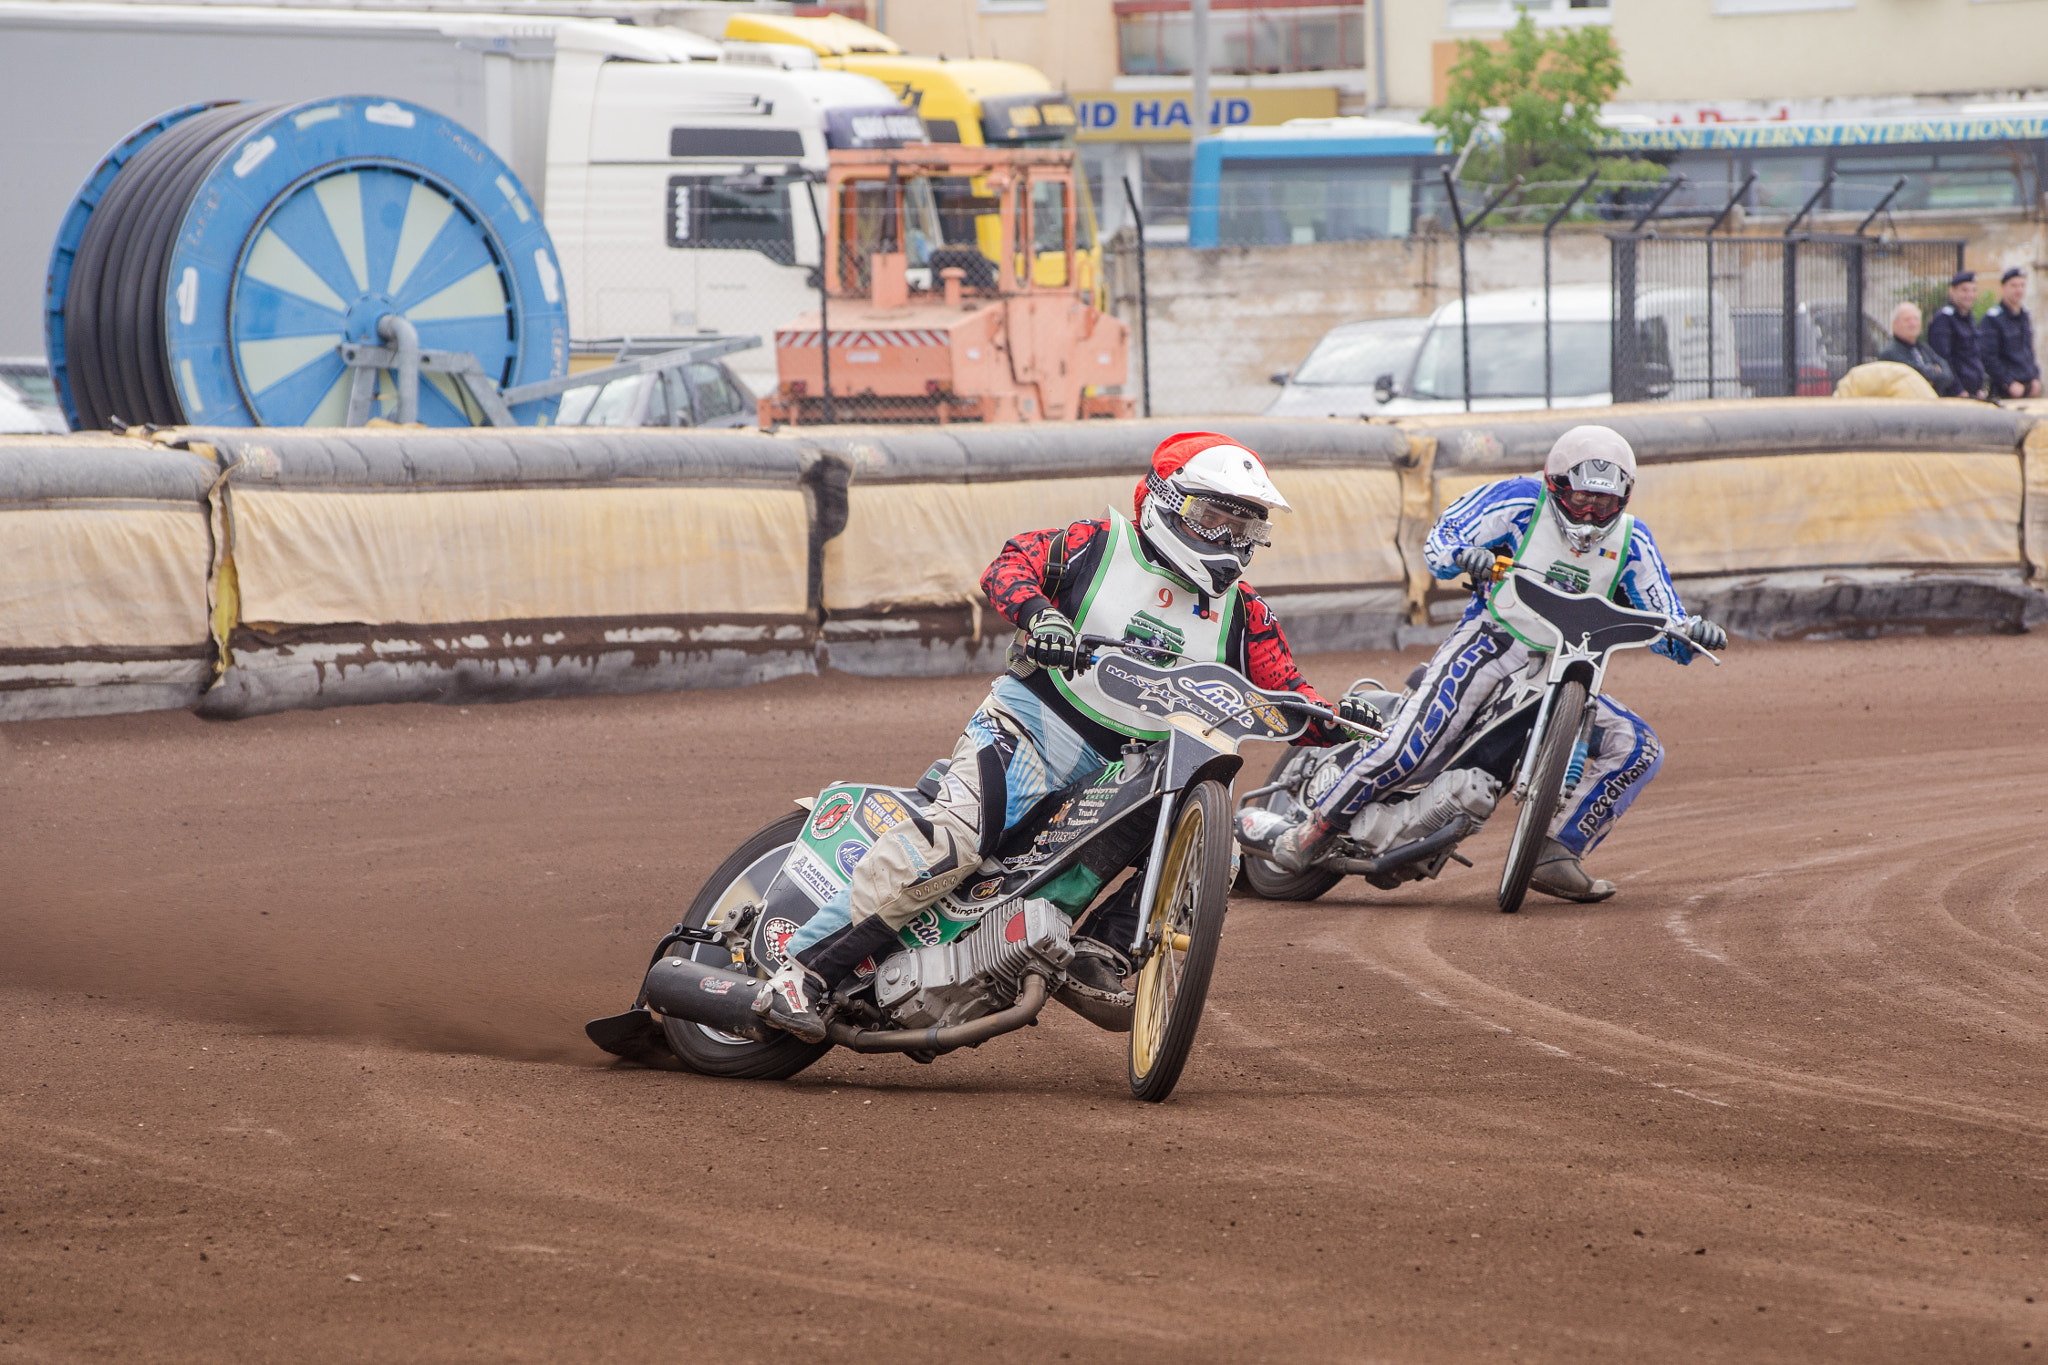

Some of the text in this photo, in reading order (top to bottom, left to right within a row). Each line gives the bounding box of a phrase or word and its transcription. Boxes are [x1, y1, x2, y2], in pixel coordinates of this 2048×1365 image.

[675, 185, 690, 240] MAN
[1587, 479, 1613, 489] HJC
[1155, 587, 1174, 609] 9
[1105, 664, 1219, 723] MAX-LAST
[1179, 677, 1254, 728] Linde
[1341, 632, 1498, 815] wulfsport
[864, 796, 887, 819] SYSTEM
[1578, 729, 1659, 837] speedwaystar
